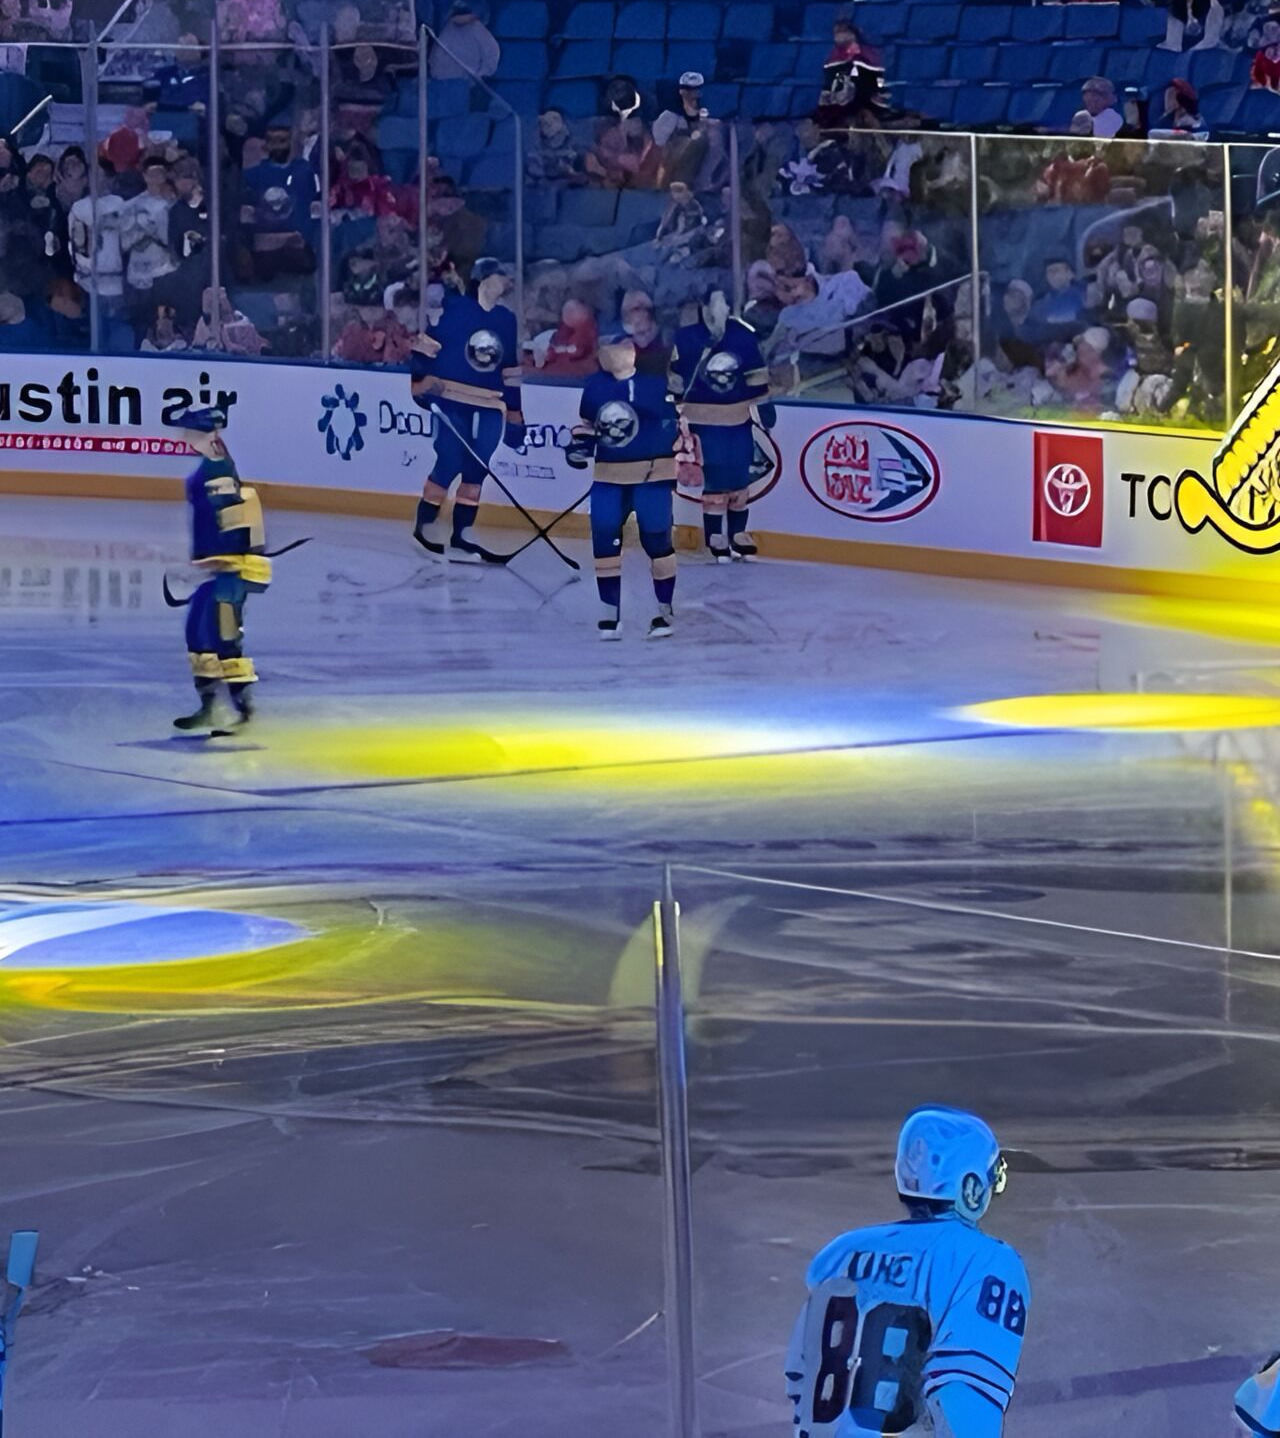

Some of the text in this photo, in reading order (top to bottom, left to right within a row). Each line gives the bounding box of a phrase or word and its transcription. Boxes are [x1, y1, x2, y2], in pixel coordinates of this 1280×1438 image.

[161, 371, 238, 429] air
[976, 1274, 1024, 1338] 88
[819, 1294, 932, 1432] 88
